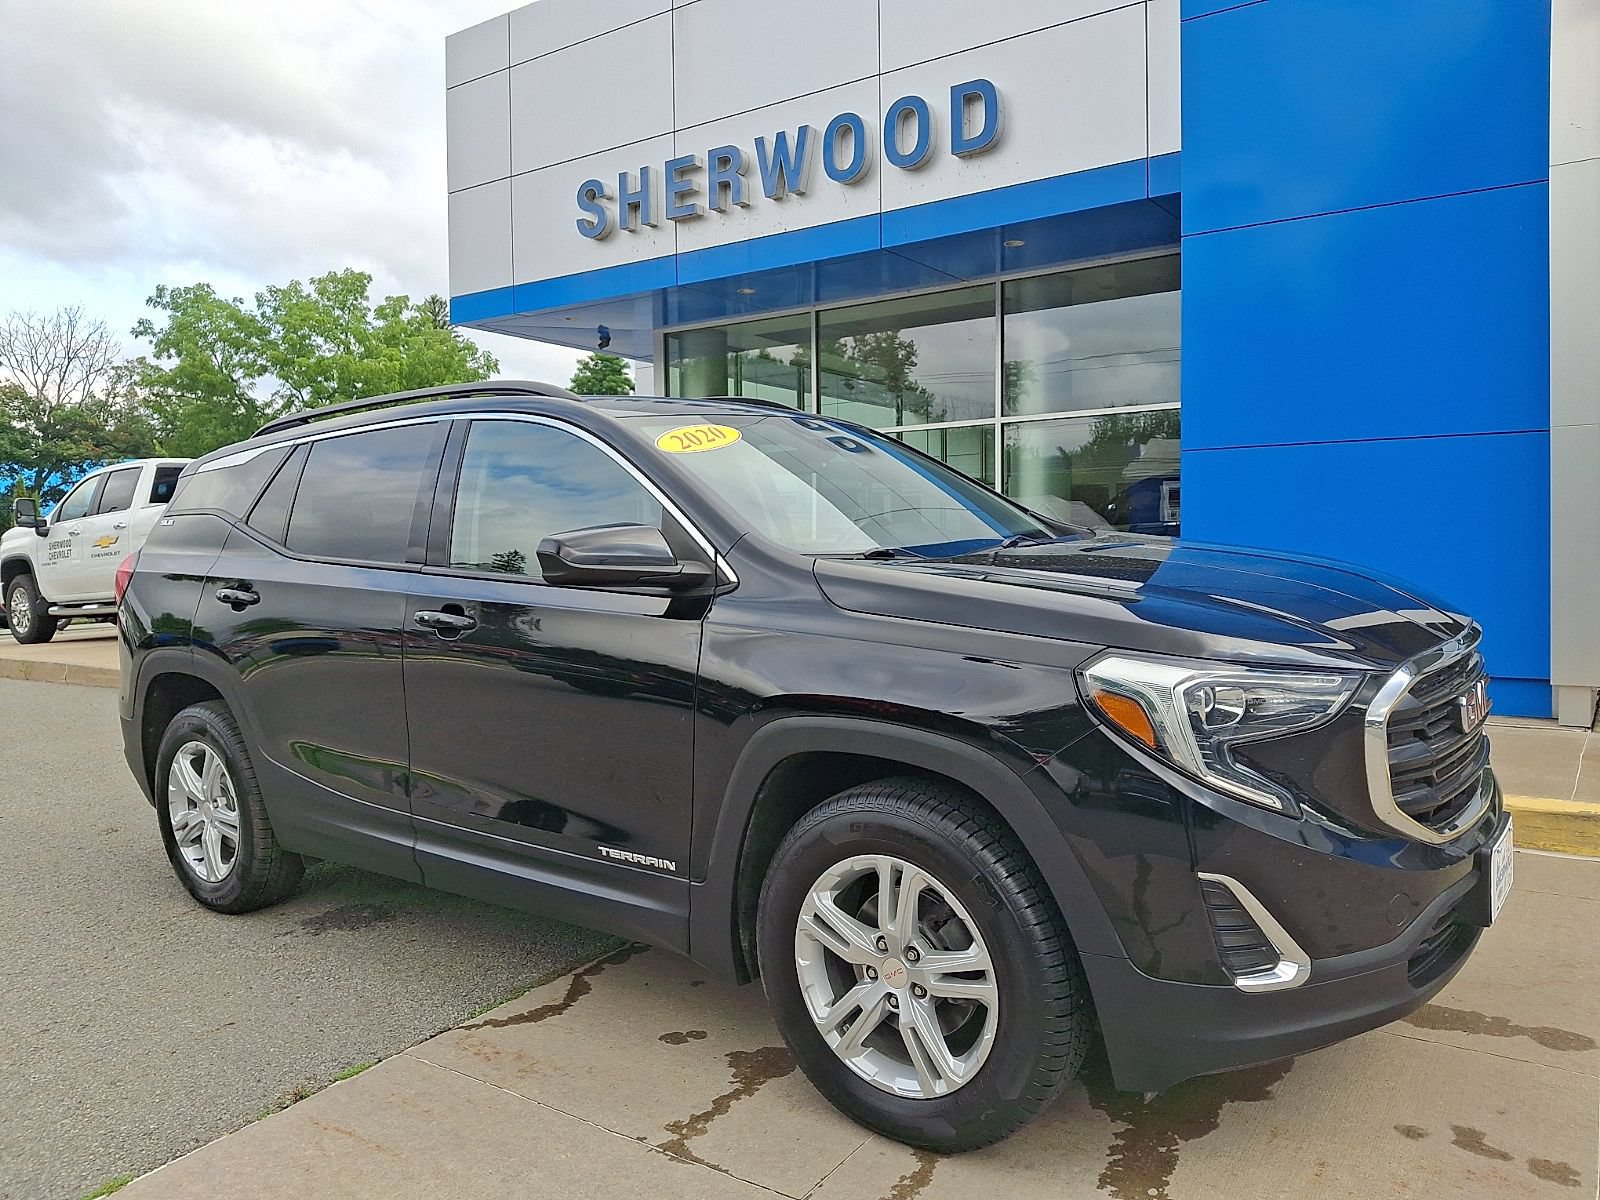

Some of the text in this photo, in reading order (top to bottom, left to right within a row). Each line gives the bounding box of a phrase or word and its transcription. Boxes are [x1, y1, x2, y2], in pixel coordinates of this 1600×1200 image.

[576, 79, 1005, 241] SHERWOOD
[670, 426, 726, 449] 2020
[48, 539, 72, 551] SHERWOOD
[48, 549, 72, 561] CHEVROLET
[90, 550, 120, 558] CHEVROLET
[597, 845, 676, 871] TERRAIN
[884, 967, 903, 980] GMC
